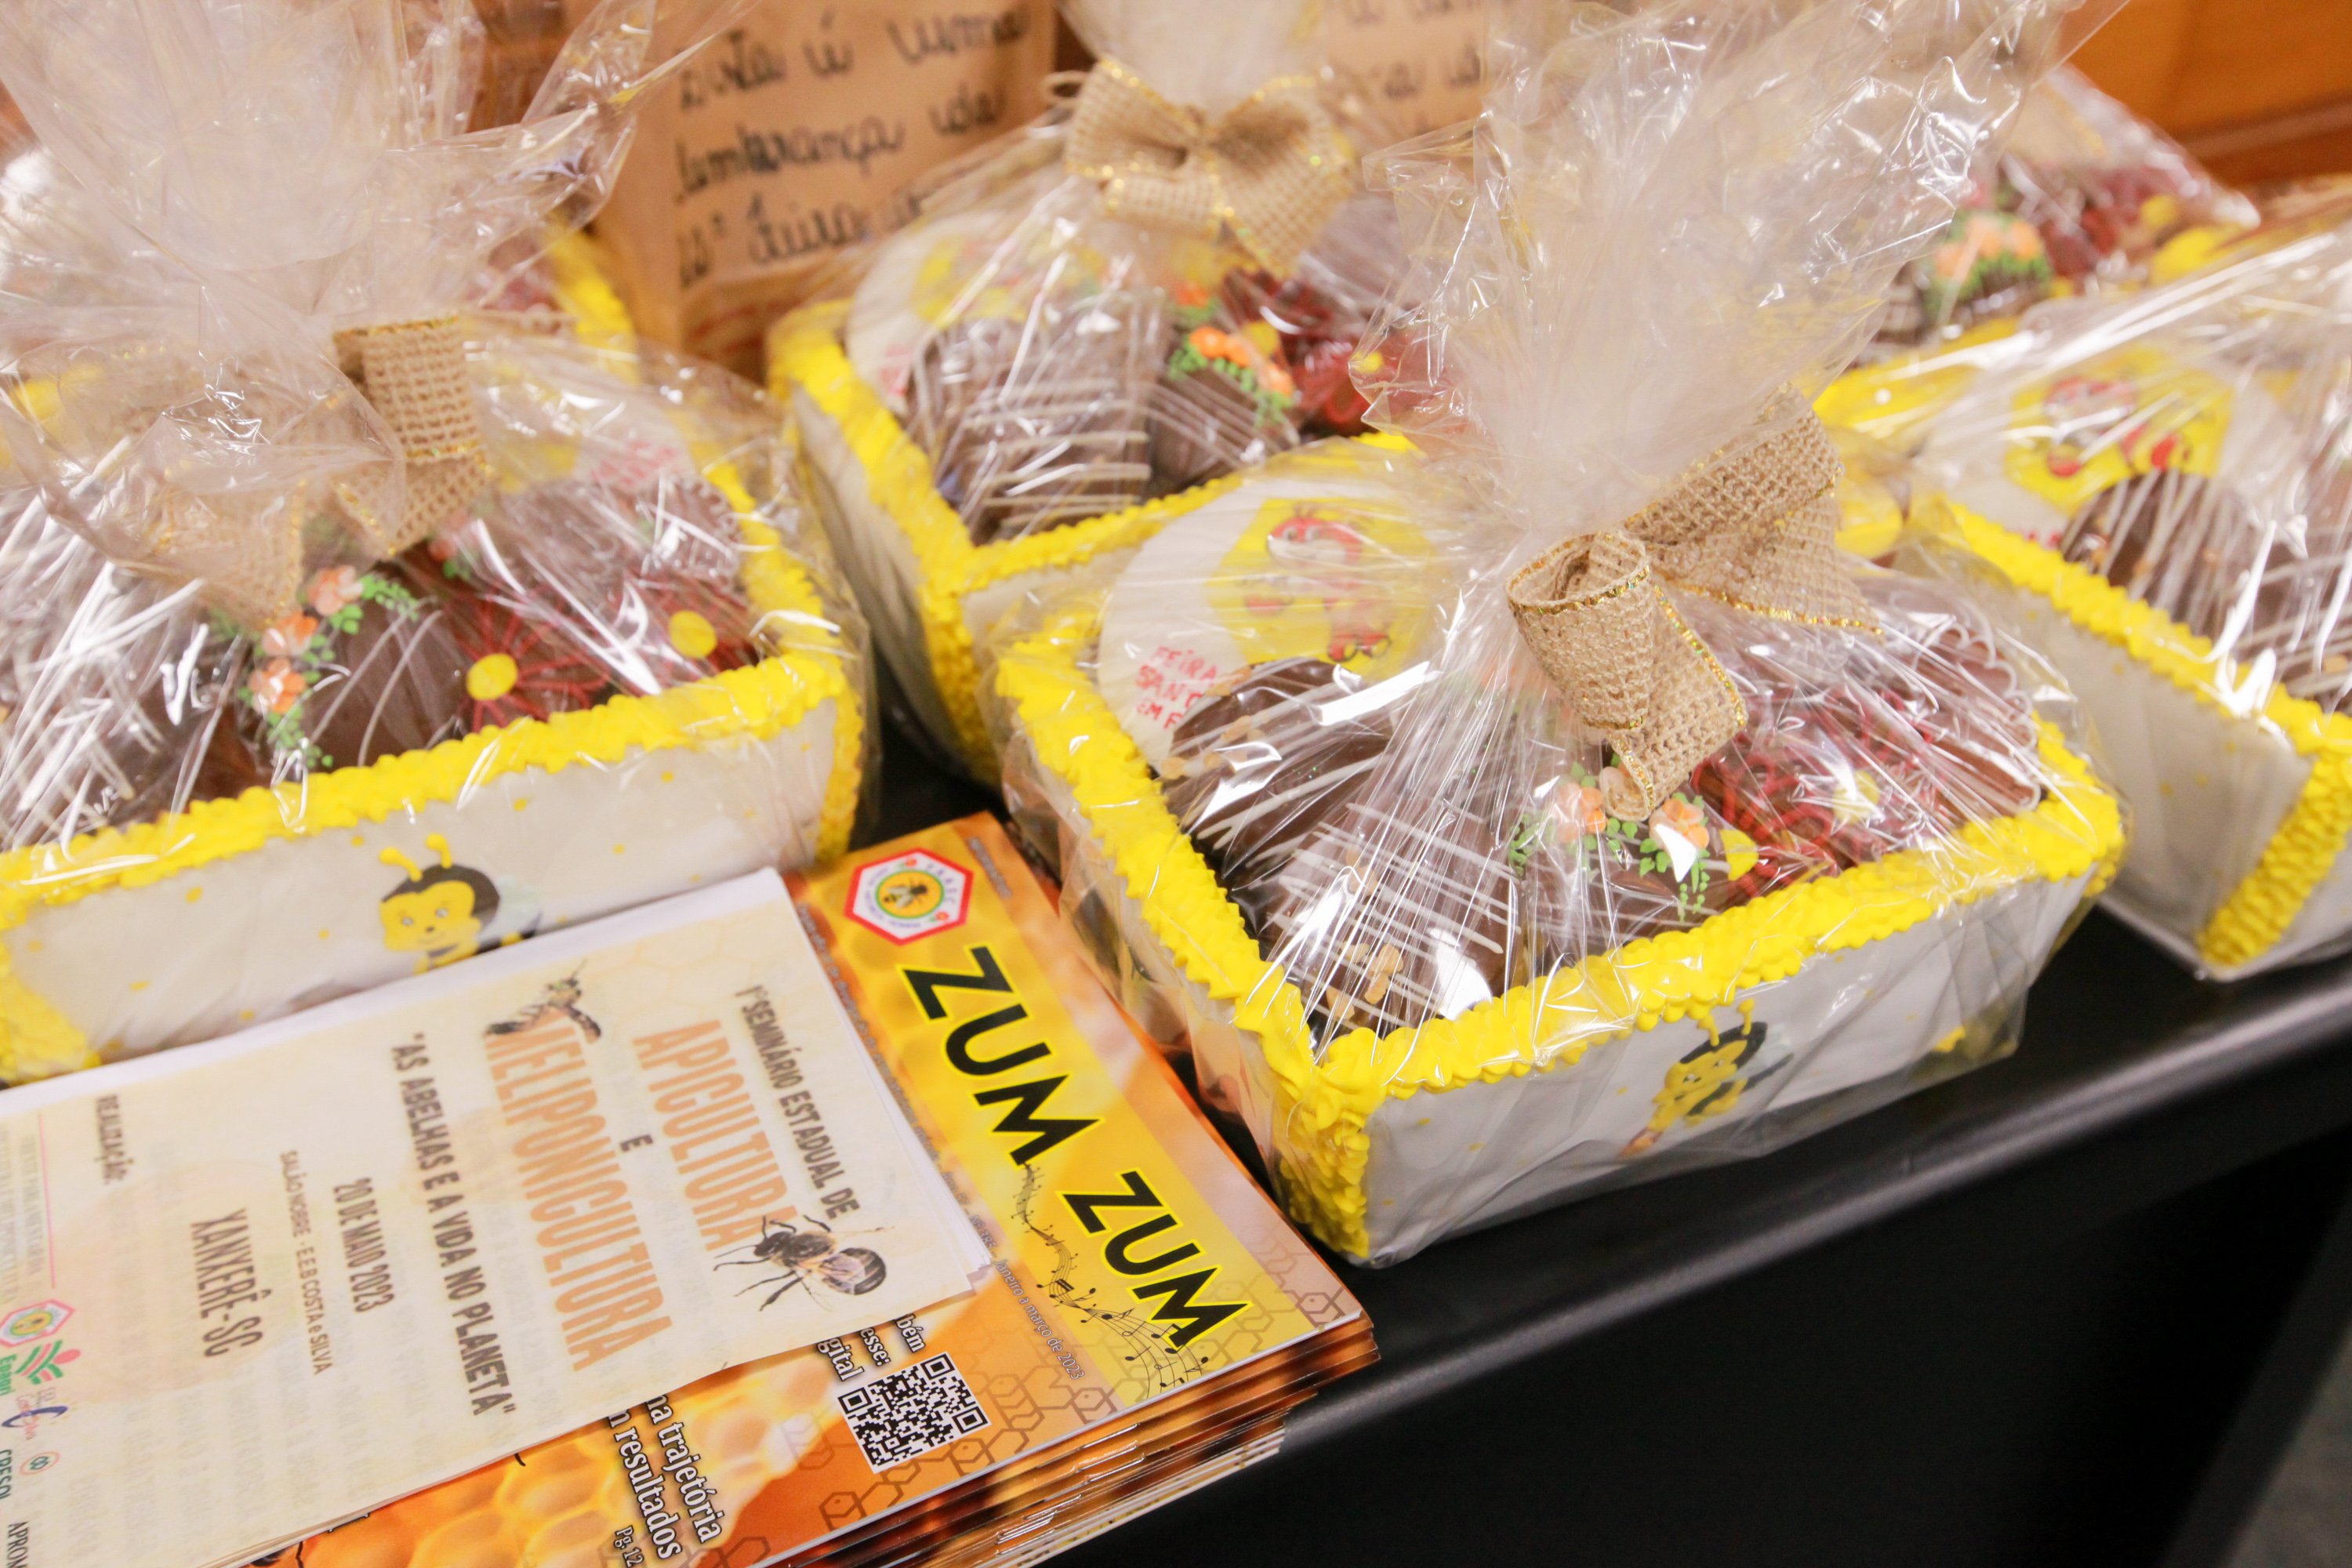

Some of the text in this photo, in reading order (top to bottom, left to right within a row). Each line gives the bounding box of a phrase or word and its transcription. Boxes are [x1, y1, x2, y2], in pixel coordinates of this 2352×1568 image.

[398, 1077, 456, 1171] ABELHAS
[619, 1133, 655, 1153] E
[631, 1018, 799, 1252] APICULTURA
[779, 1090, 846, 1189] ESTADUAL
[819, 1187, 861, 1221] DE
[900, 944, 1253, 1350] ZUM ZUM
[422, 1171, 460, 1191] E
[482, 1007, 673, 1373] MELIPONICULTURA
[426, 1193, 465, 1214] A
[332, 1177, 395, 1313] 20 DE MAIO 2023
[432, 1210, 477, 1269] VIDA
[443, 1265, 487, 1301] NO
[993, 1258, 1025, 1297] Janeiro
[300, 1279, 325, 1326] COSTA
[1018, 1296, 1030, 1305] a
[1023, 1303, 1053, 1338] março
[307, 1324, 323, 1334] e
[1047, 1337, 1064, 1353] de
[308, 1333, 333, 1375] SILVA
[451, 1301, 517, 1416] PLANETA"
[1057, 1350, 1086, 1381] 2023
[613, 1426, 683, 1560] resultados
[658, 1421, 726, 1544] trajetória
[622, 1546, 645, 1568] 12
